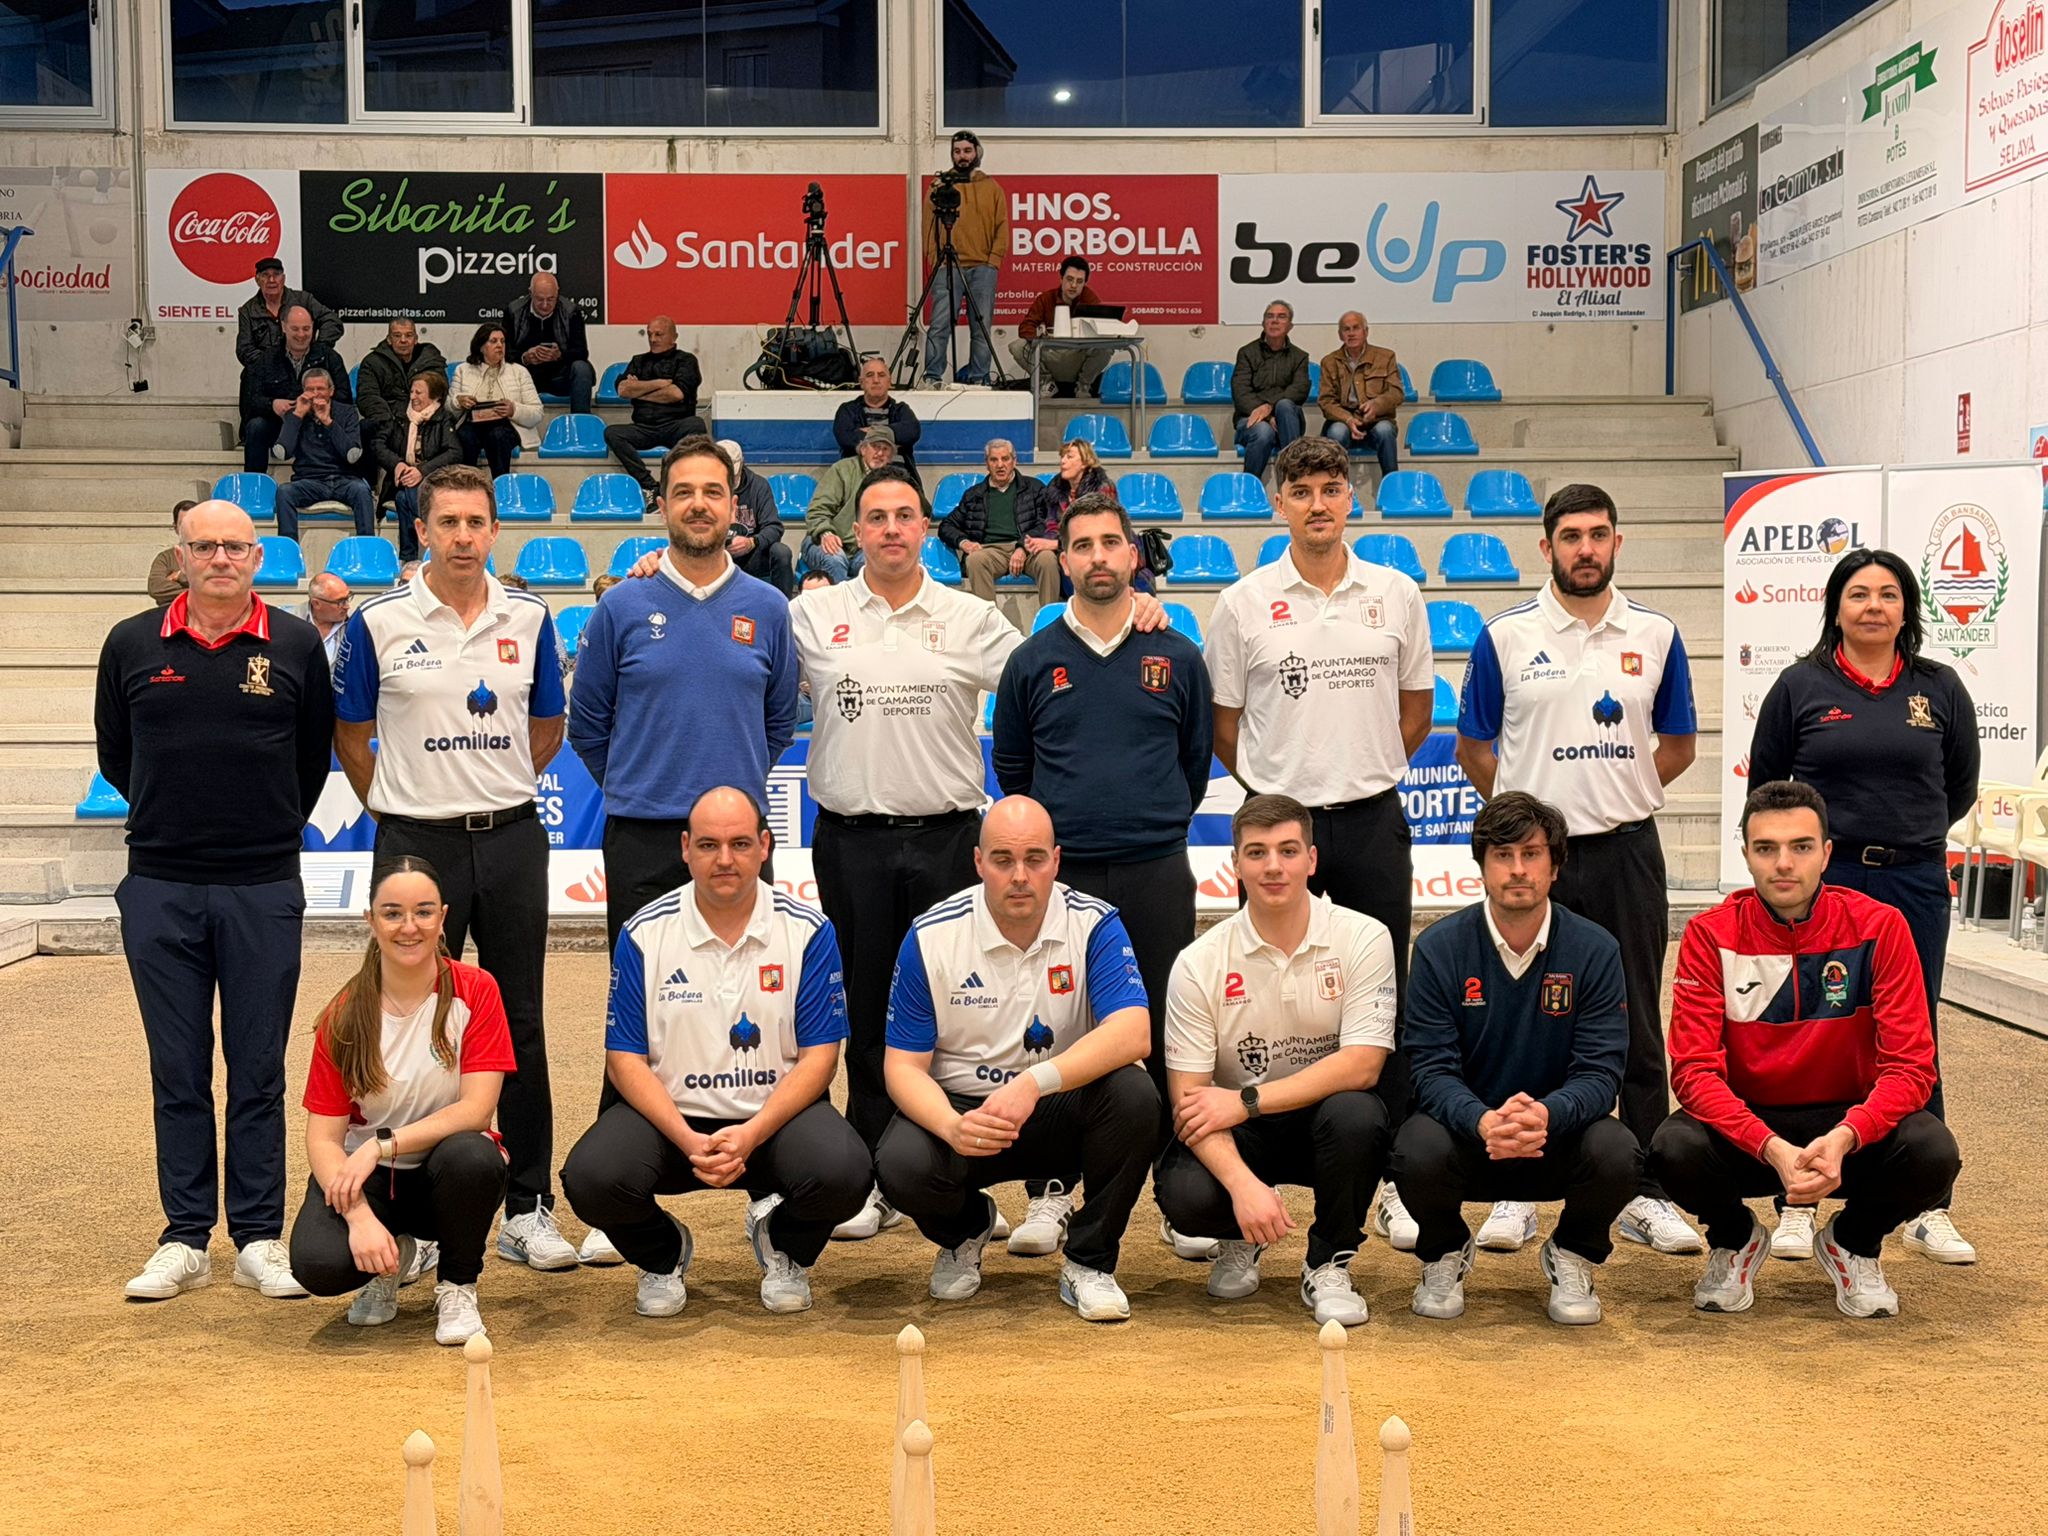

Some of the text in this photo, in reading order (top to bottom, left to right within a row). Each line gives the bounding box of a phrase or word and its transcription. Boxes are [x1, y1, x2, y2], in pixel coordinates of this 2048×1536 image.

[1978, 90, 2014, 118] Sobaos
[1989, 123, 1996, 144] y
[1886, 140, 1907, 164] POTES
[2000, 134, 2036, 167] SELAYA
[329, 177, 576, 234] Sibarita's
[1012, 192, 1121, 222] HNOS.
[174, 210, 275, 244] Coca-Cola
[1012, 227, 1202, 256] BORBOLLA
[1527, 243, 1651, 266] FOSTER'S
[15, 263, 111, 288] ociedad
[418, 244, 558, 294] pizzería
[1012, 260, 1203, 272] MATERIA DE CONSTRUCCIÓN
[1527, 266, 1651, 289] HOLLYWOOD
[1557, 289, 1622, 307] El Alisal
[158, 306, 234, 318] SIENTE EL
[478, 308, 504, 318] Calle
[1736, 556, 1783, 566] ASOCIACIÓN
[1784, 556, 1793, 564] DE
[1796, 554, 1821, 563] PEÑAS
[1824, 555, 1835, 563] DE
[1270, 600, 1291, 620] 2
[831, 624, 850, 643] 2
[1937, 628, 1990, 642] SANTANDER
[405, 657, 442, 670] Bolera
[1311, 656, 1390, 669] AYUNTAMIENTO
[1053, 667, 1068, 686] 2
[1323, 667, 1376, 679] CAMARGO
[1520, 668, 1566, 683] La Bolera
[866, 684, 948, 694] AYUNTAMIENTO
[1329, 679, 1375, 690] DEPORTES
[878, 695, 932, 705] CAMARGO
[883, 707, 931, 716] DEPORTES
[1978, 723, 2027, 740] ander
[424, 731, 511, 752] comillas
[1552, 740, 1635, 761] comillas
[1404, 764, 1467, 786] MUNICI
[1225, 972, 1246, 998] 2
[1464, 977, 1482, 999] 2
[667, 990, 702, 1001] Bolera
[950, 995, 998, 1006] La Bolera
[1271, 1033, 1340, 1050] AYUNTAMIEN
[1272, 1041, 1340, 1061] DE CAMARGO
[1290, 1056, 1323, 1065] DEPO
[684, 1067, 777, 1090] comillas
